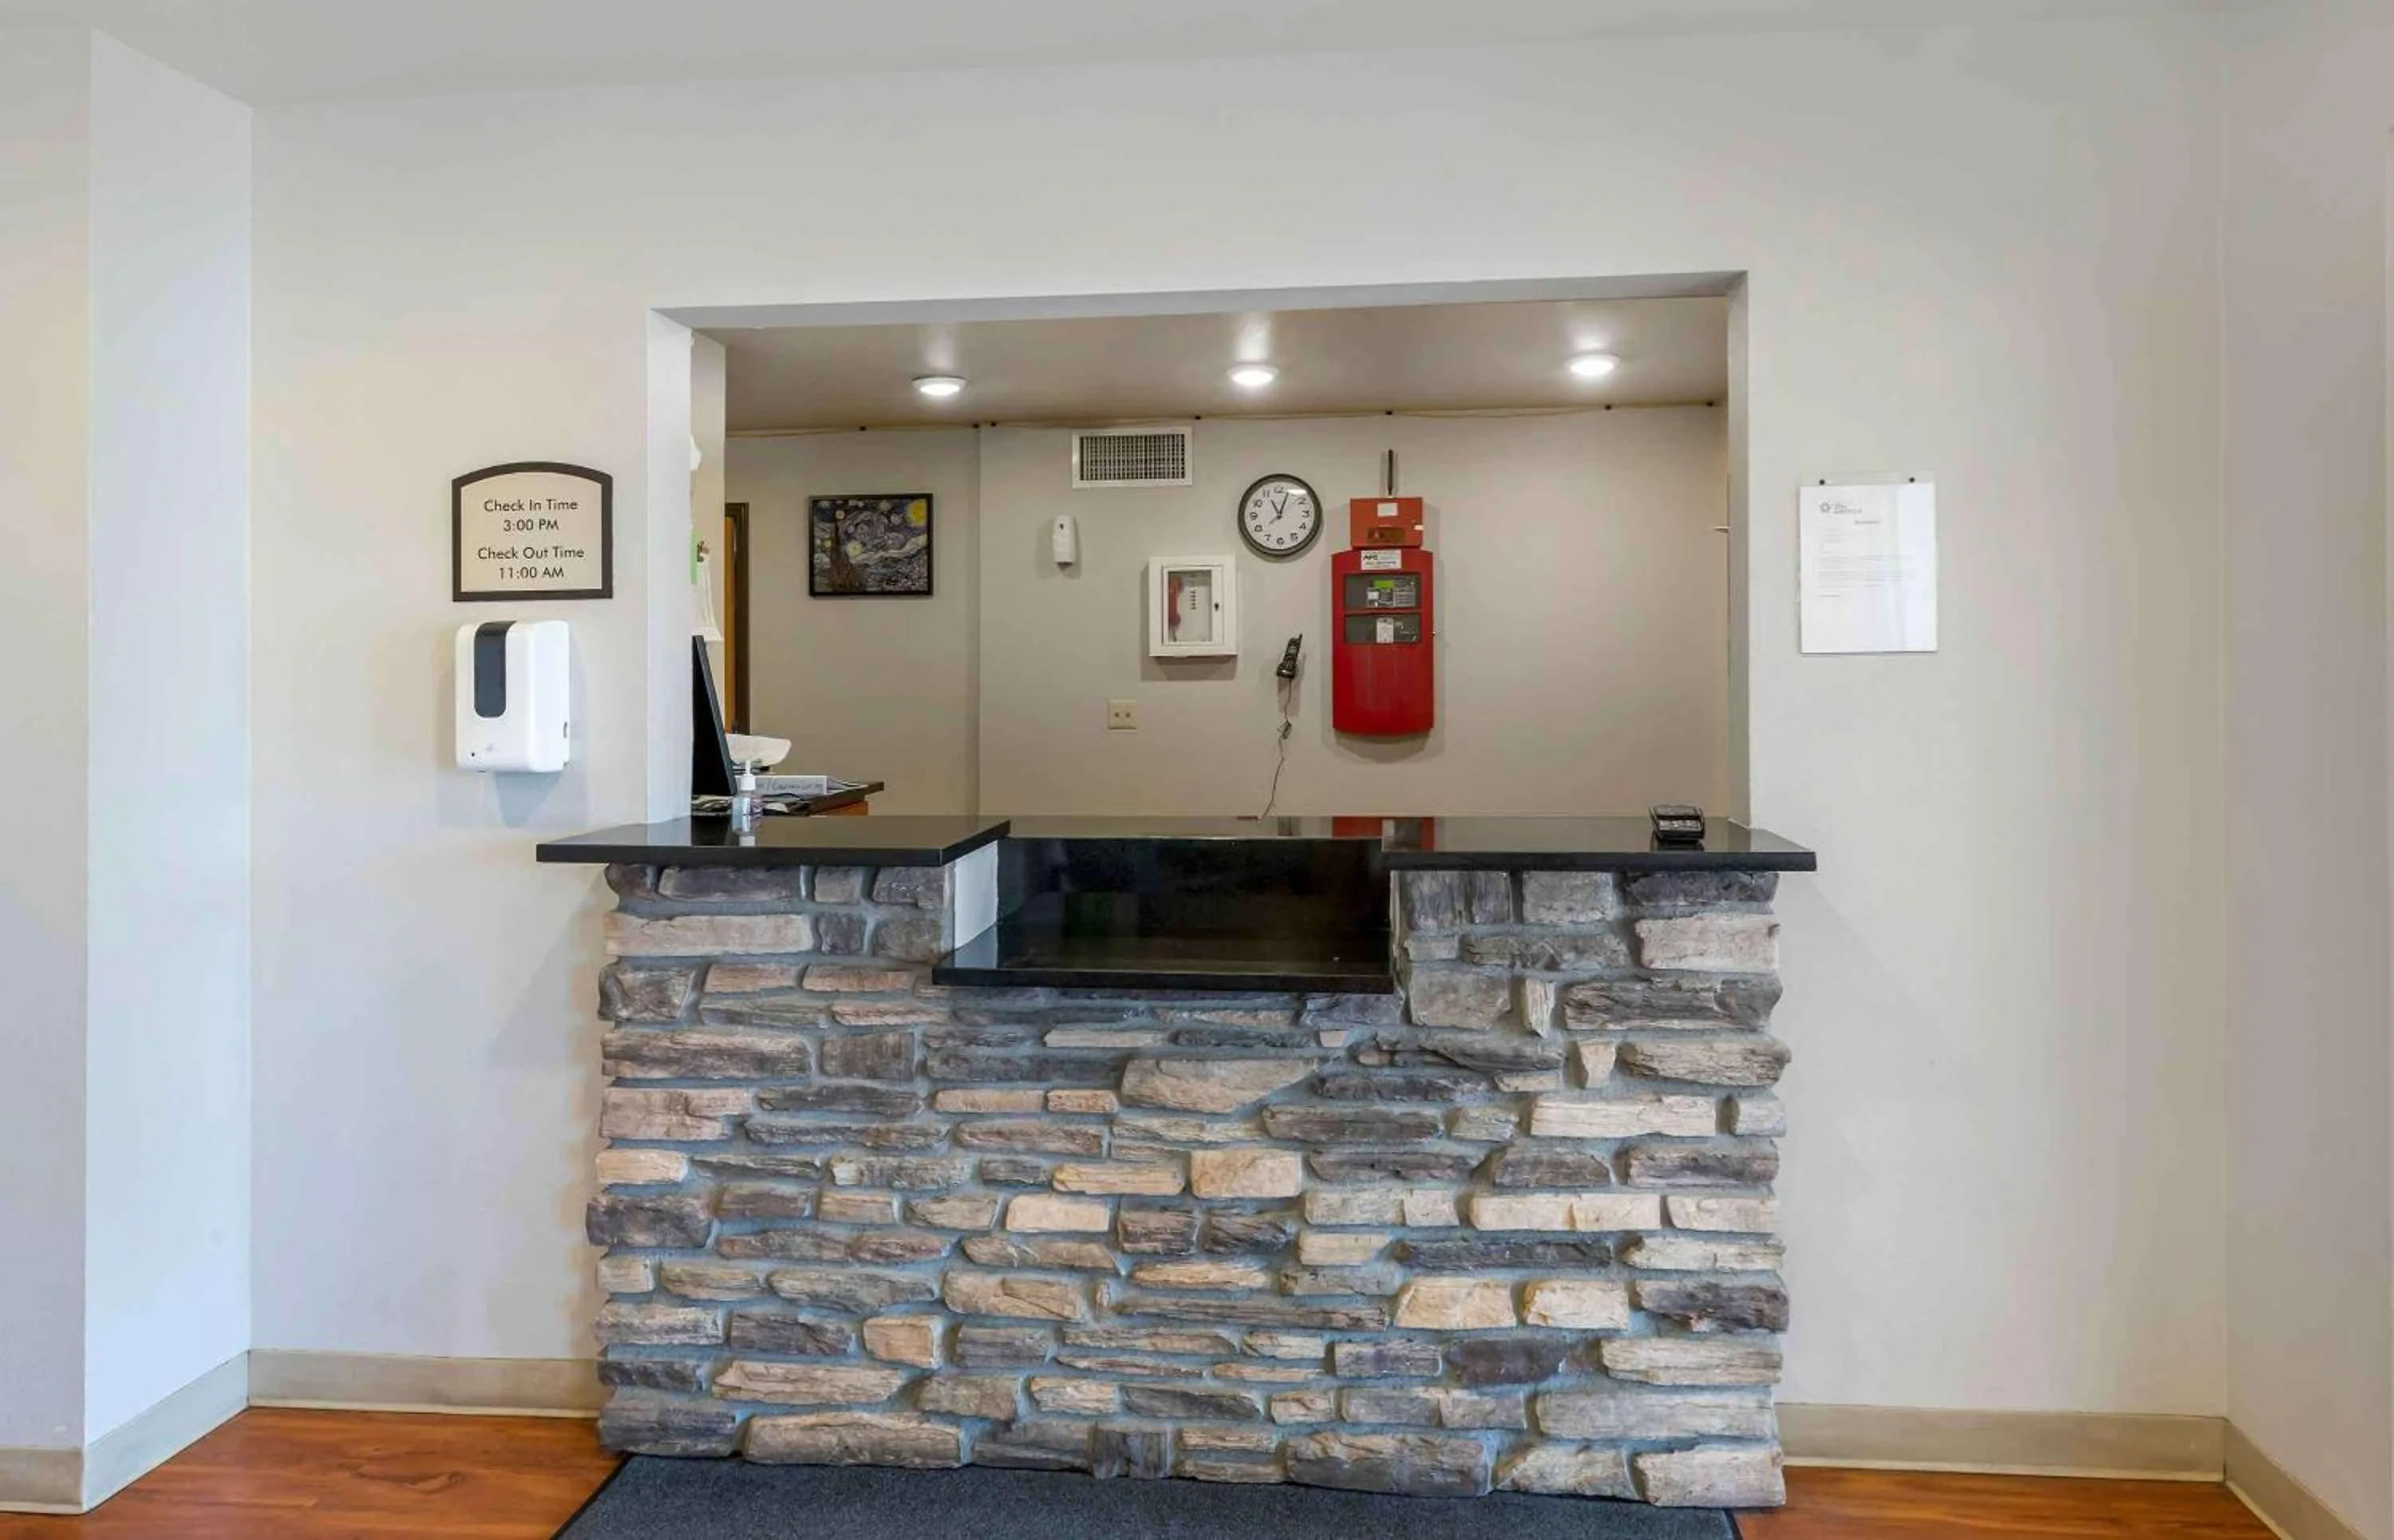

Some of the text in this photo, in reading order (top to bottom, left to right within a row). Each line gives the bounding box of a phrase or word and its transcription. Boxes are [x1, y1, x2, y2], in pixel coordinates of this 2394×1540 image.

[484, 499, 579, 511] Check In Time
[503, 519, 559, 532] 3:00 PM
[478, 545, 585, 559] Check Out Time
[499, 567, 564, 578] 11:00 AM
